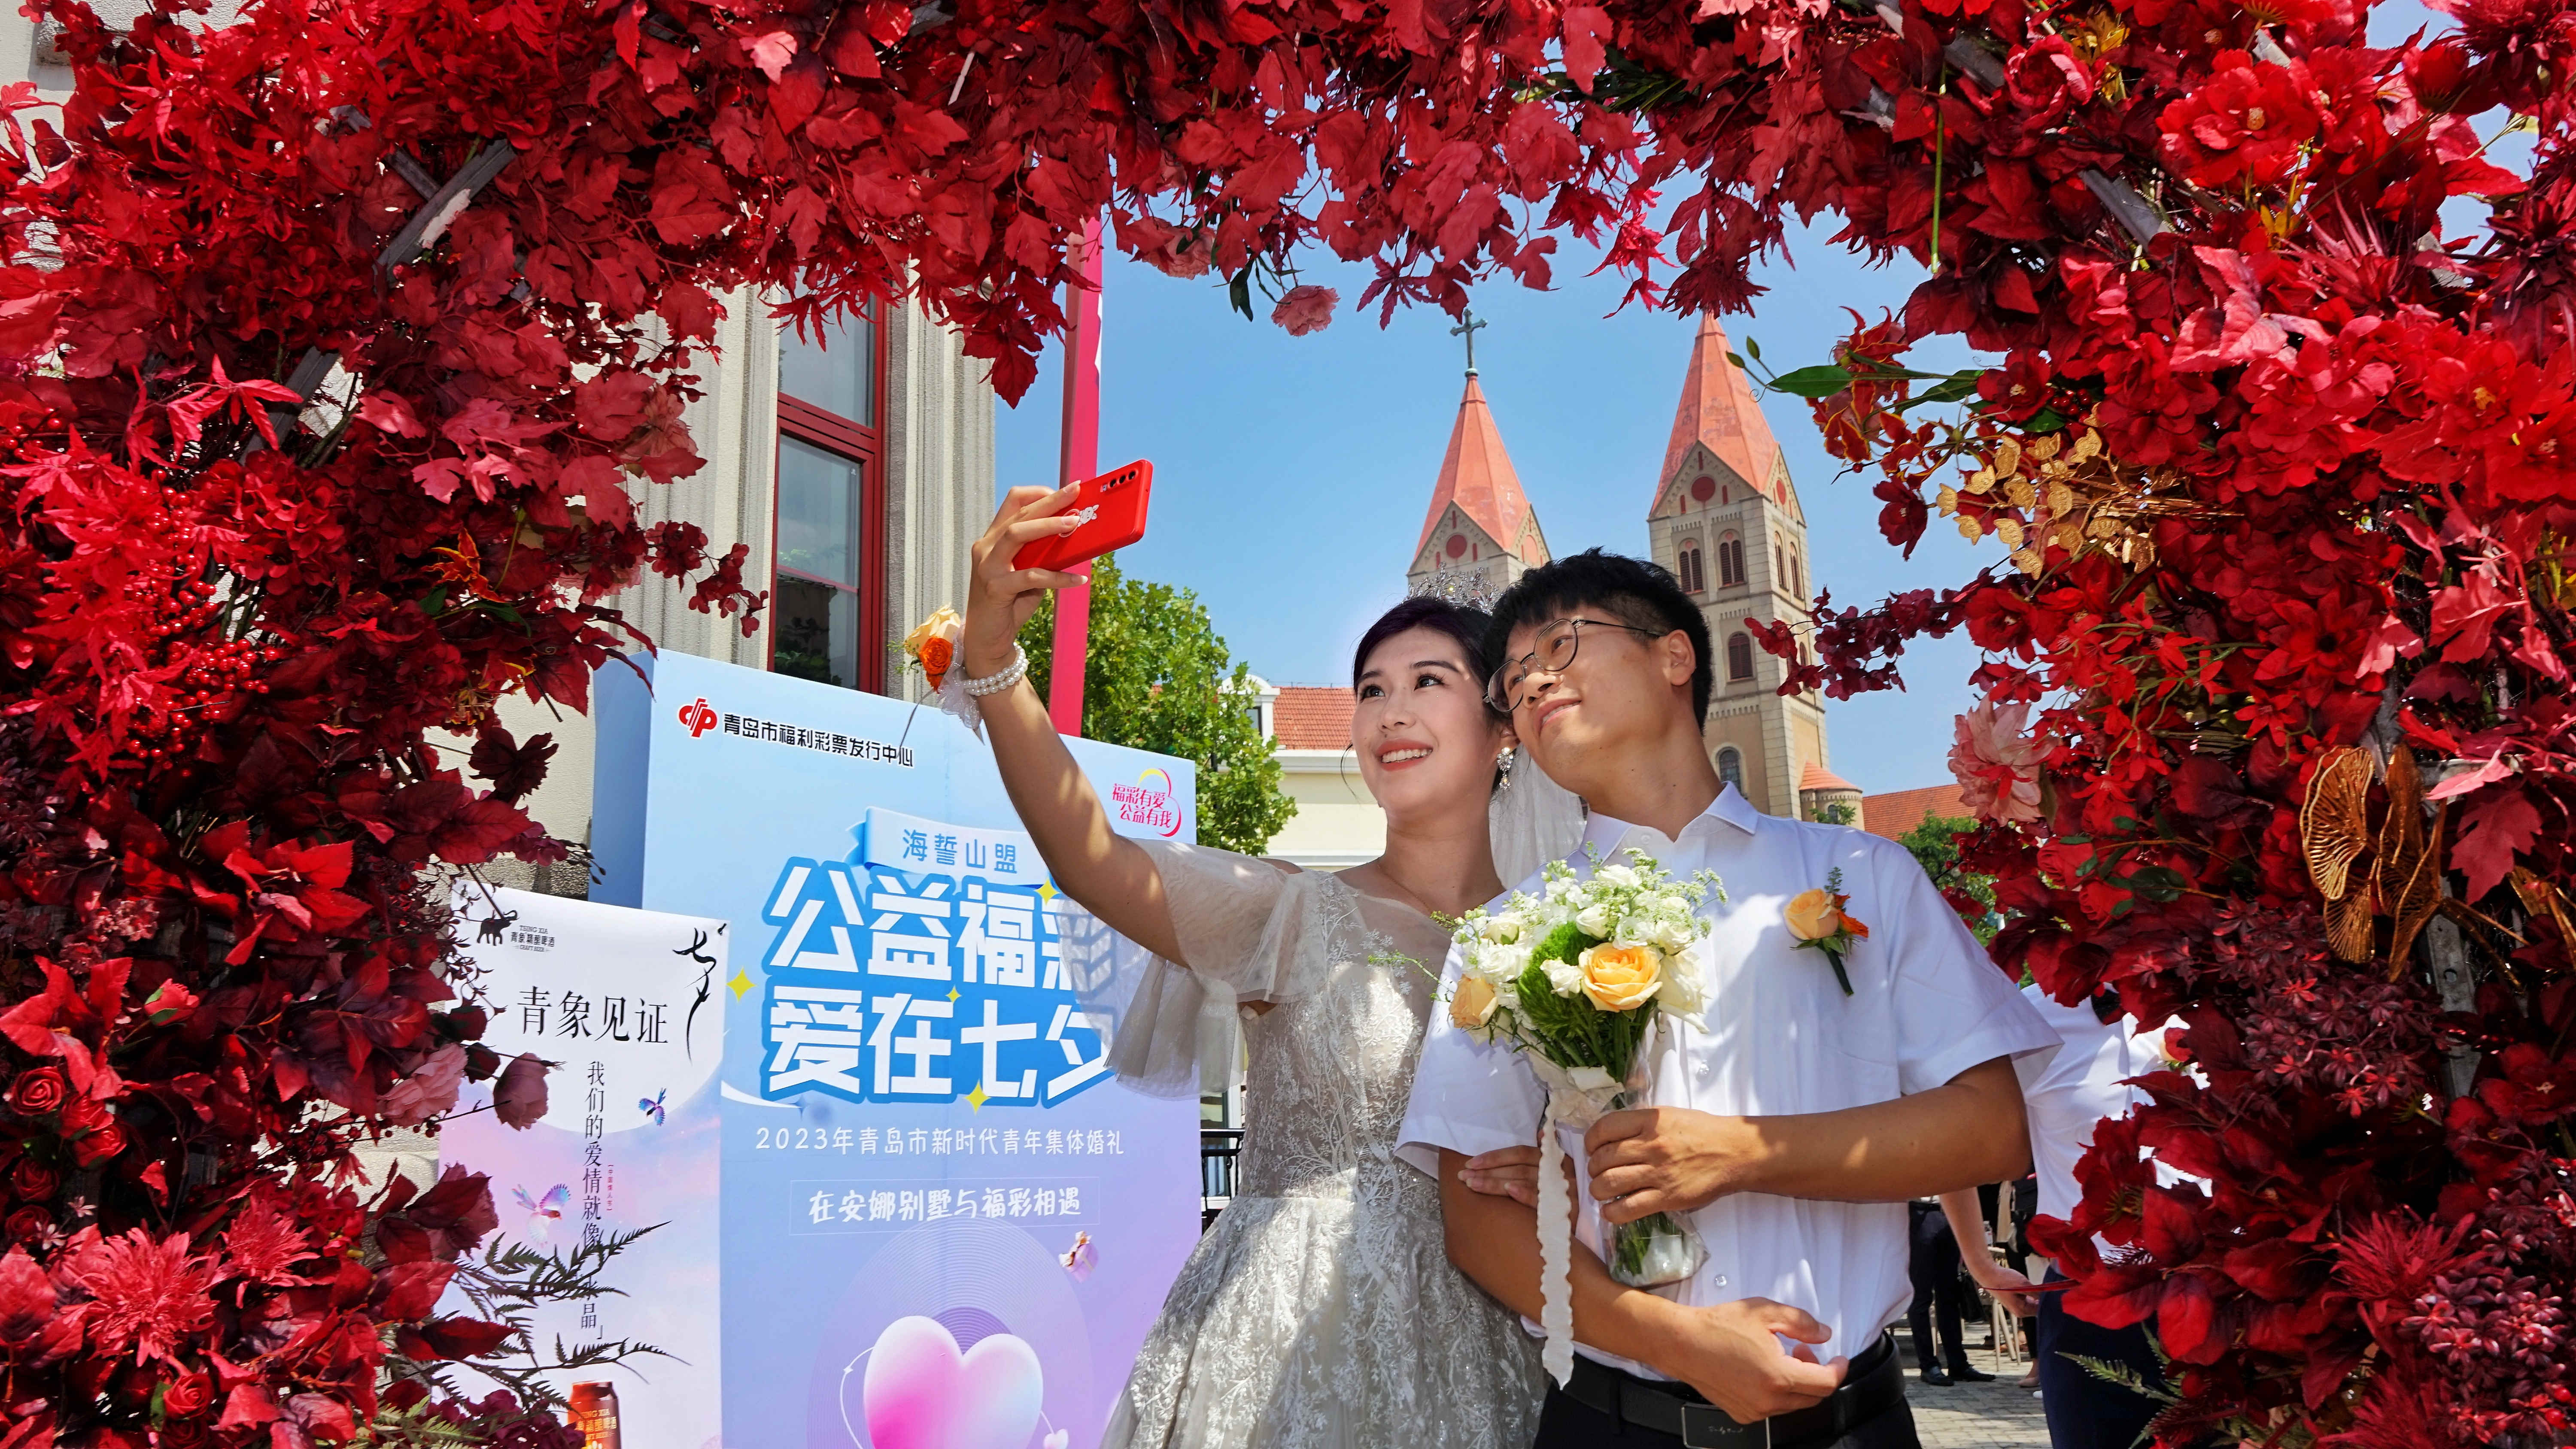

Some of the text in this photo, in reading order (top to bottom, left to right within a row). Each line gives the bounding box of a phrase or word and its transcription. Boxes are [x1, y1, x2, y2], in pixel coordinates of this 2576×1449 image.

[724, 714, 913, 767] 青岛市福利彩票发行中心
[1112, 783, 1166, 809] 福彩有爱
[1120, 803, 1173, 828] 公益有我
[903, 828, 1018, 874] 海誓山盟
[769, 866, 1112, 992] 公益福彩
[517, 985, 668, 1043] 青象见证
[769, 986, 1113, 1100] 爱在七夕
[756, 1126, 1124, 1155] 2023年青岛市新时代青年集体婚礼
[808, 1187, 1081, 1224] 在安娜别墅与福彩相遇
